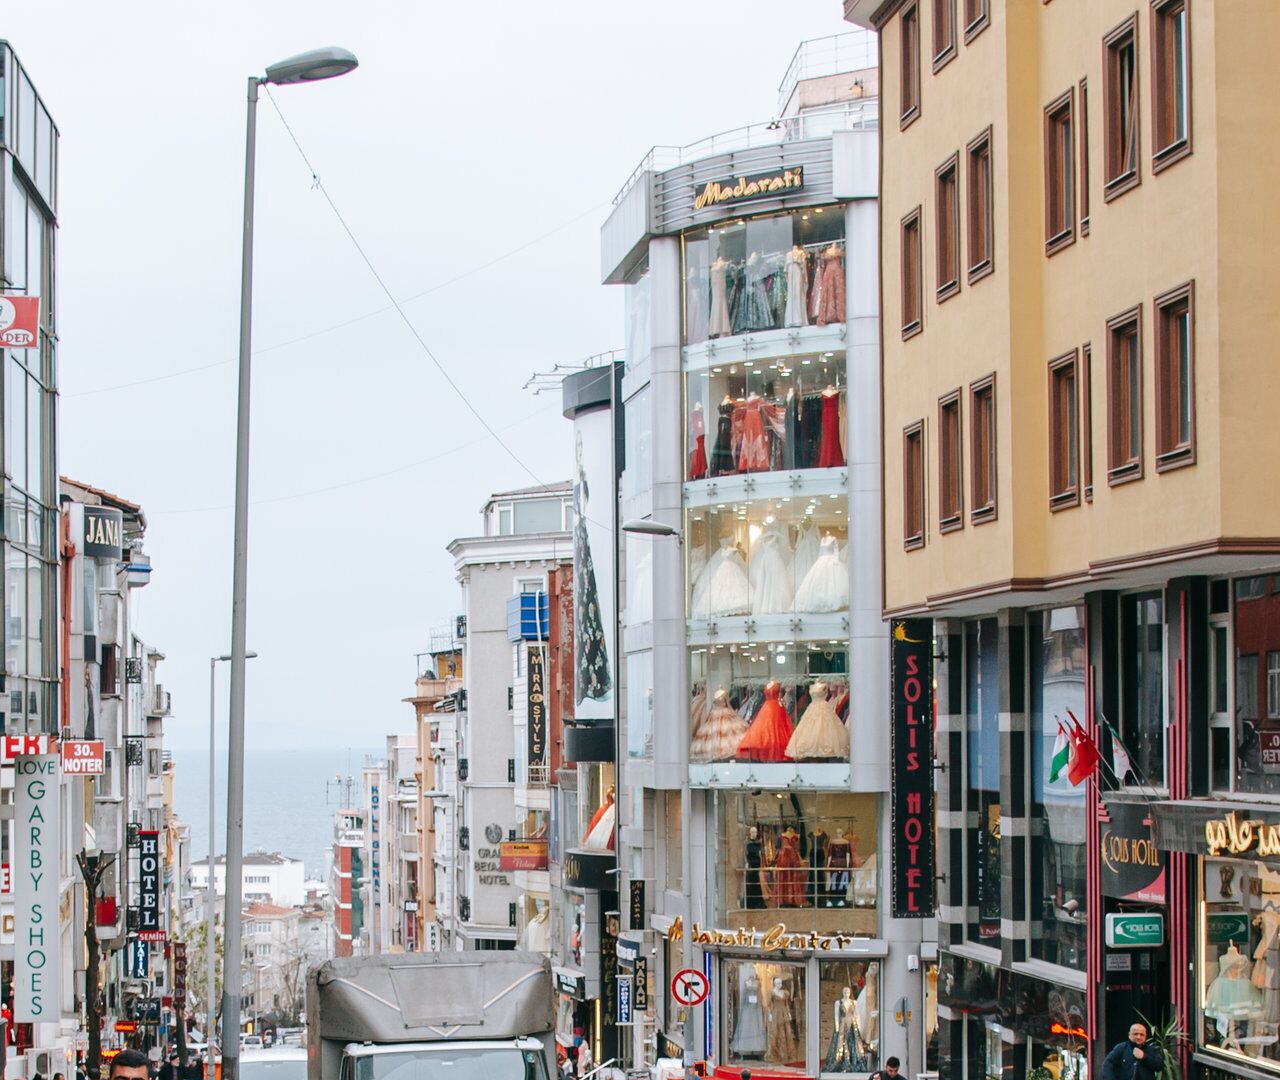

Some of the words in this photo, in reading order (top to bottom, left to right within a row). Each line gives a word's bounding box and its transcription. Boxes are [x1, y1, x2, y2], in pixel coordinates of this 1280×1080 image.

[694, 166, 801, 209] Madarati
[531, 655, 542, 692] MIRA
[532, 705, 541, 754] STYLE
[903, 655, 921, 771] SOLIS
[17, 760, 55, 775] LOVE
[64, 758, 103, 772] NOTER
[73, 744, 94, 756] 30.
[27, 780, 46, 892] GARBY
[904, 793, 922, 912] HOTEL
[1109, 836, 1130, 864] SOLIS
[141, 839, 156, 926] HOTEL
[479, 874, 510, 887] HOTEL
[138, 931, 166, 941] SEMİH
[27, 904, 46, 1015] SHOES
[636, 960, 646, 1004] MADAM
